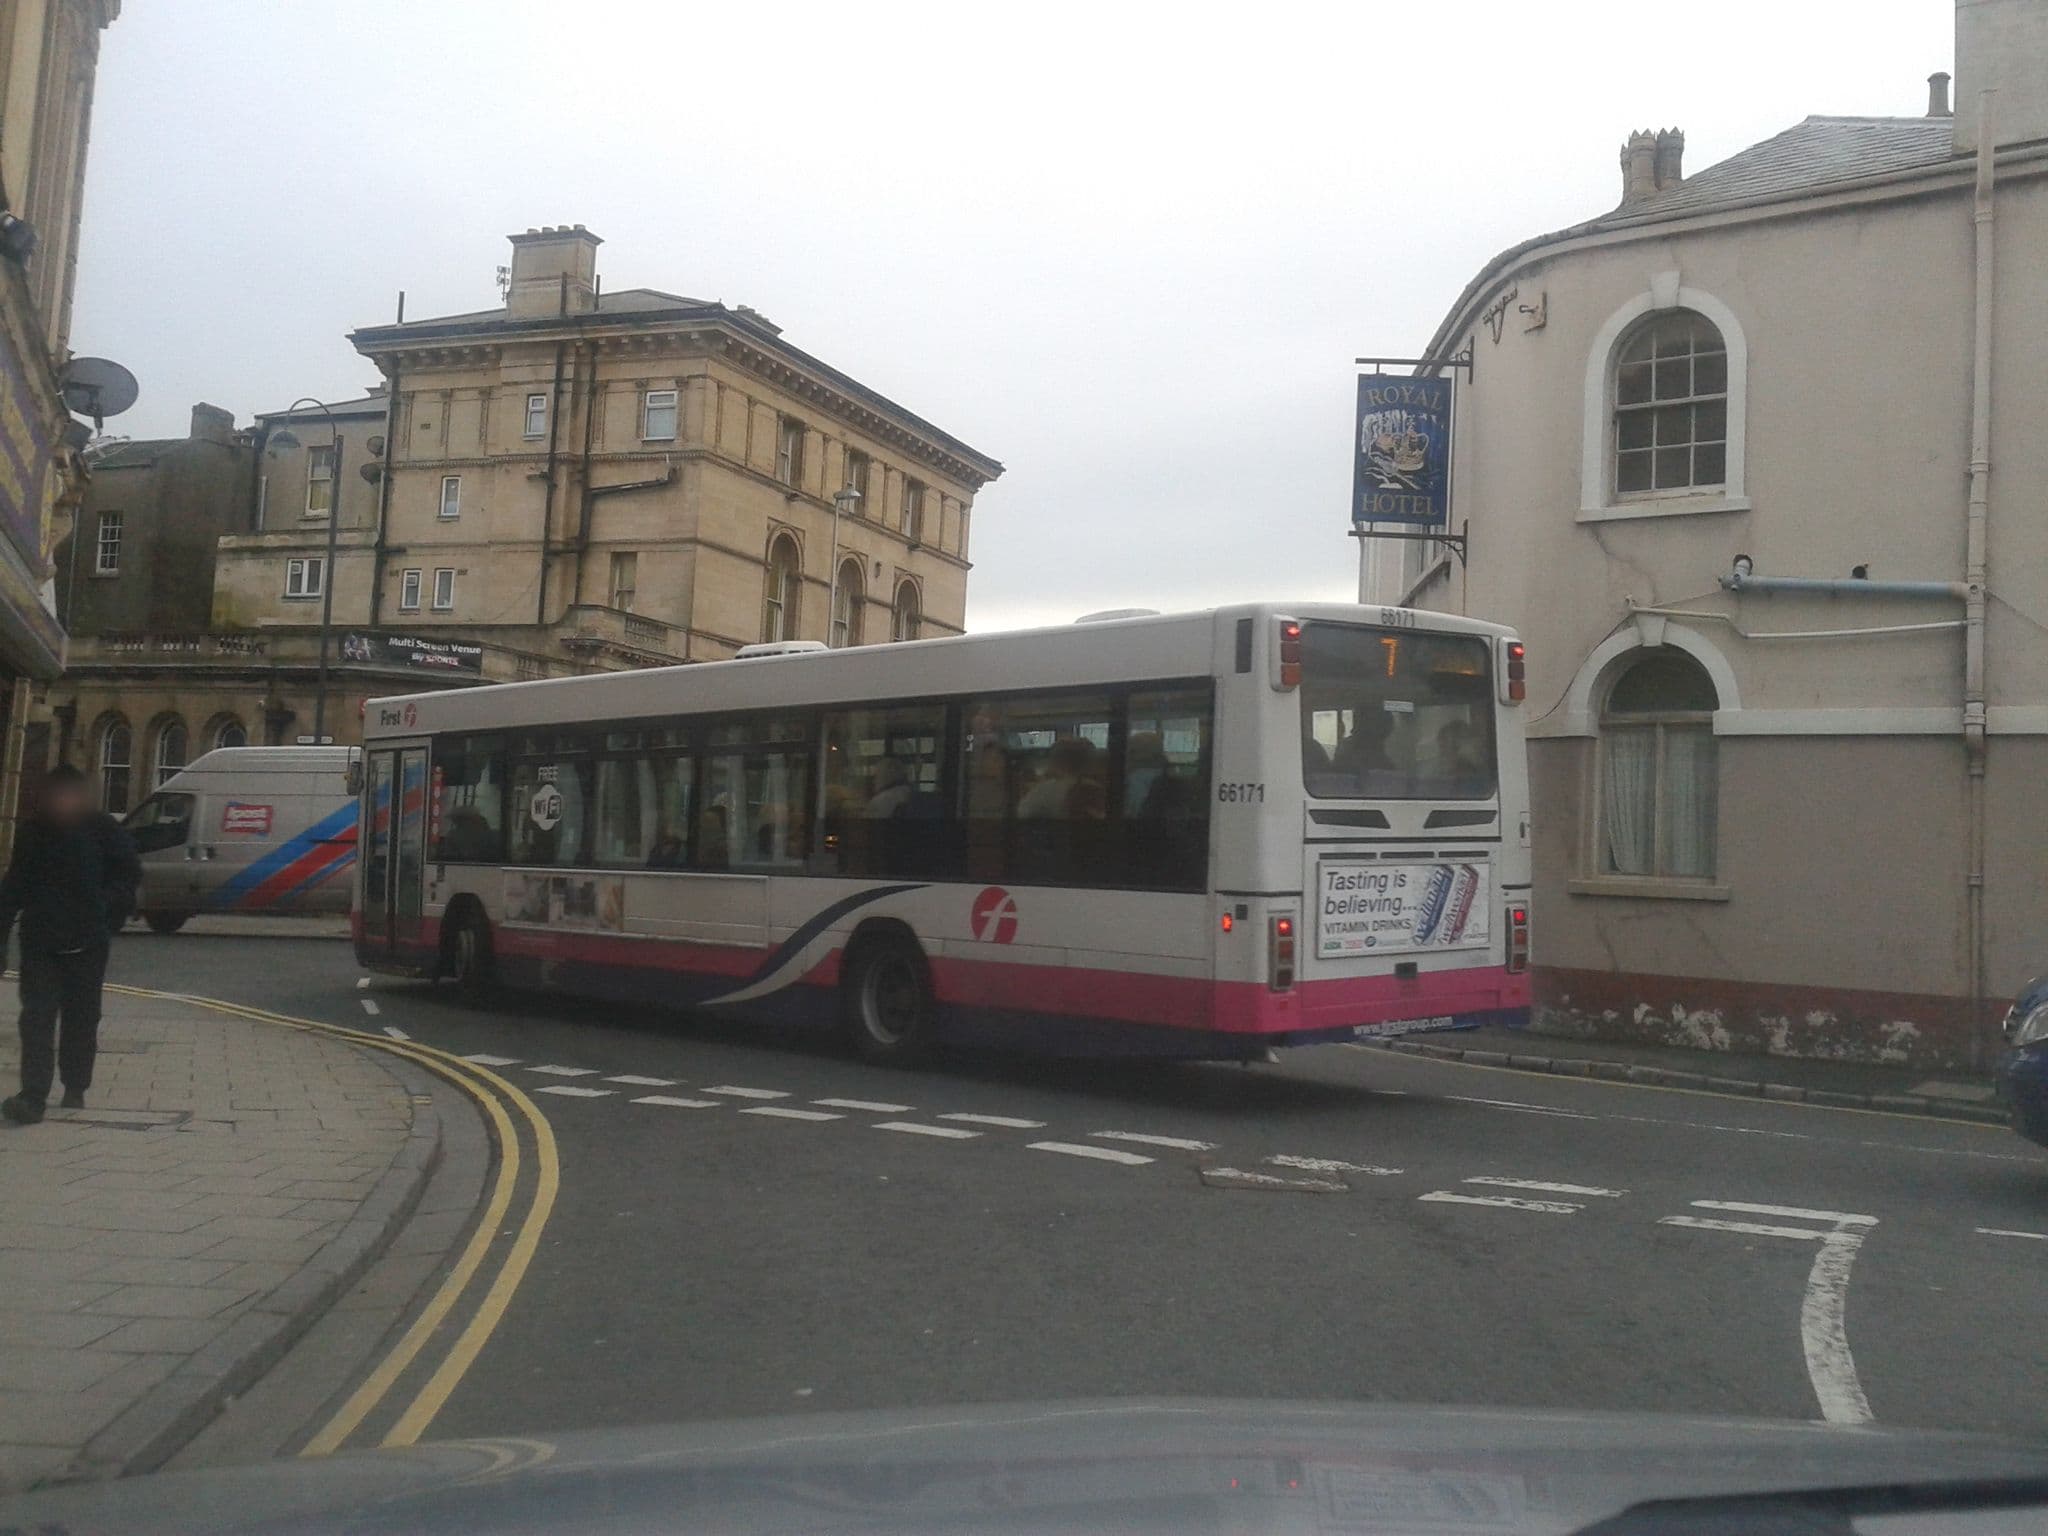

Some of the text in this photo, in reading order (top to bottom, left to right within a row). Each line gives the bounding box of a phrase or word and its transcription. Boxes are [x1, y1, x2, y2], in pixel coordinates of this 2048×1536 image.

[1366, 385, 1442, 411] ROYAL
[1361, 493, 1439, 516] HOTEL
[1380, 607, 1415, 627] 66171
[389, 637, 482, 654] Multi Screen Venue
[1380, 637, 1398, 678] 7
[381, 710, 401, 726] First
[538, 766, 559, 781] FREE
[1218, 783, 1265, 803] 66171
[1327, 869, 1407, 893] Tasting is
[1325, 918, 1411, 935] VITAMIN DRINKS
